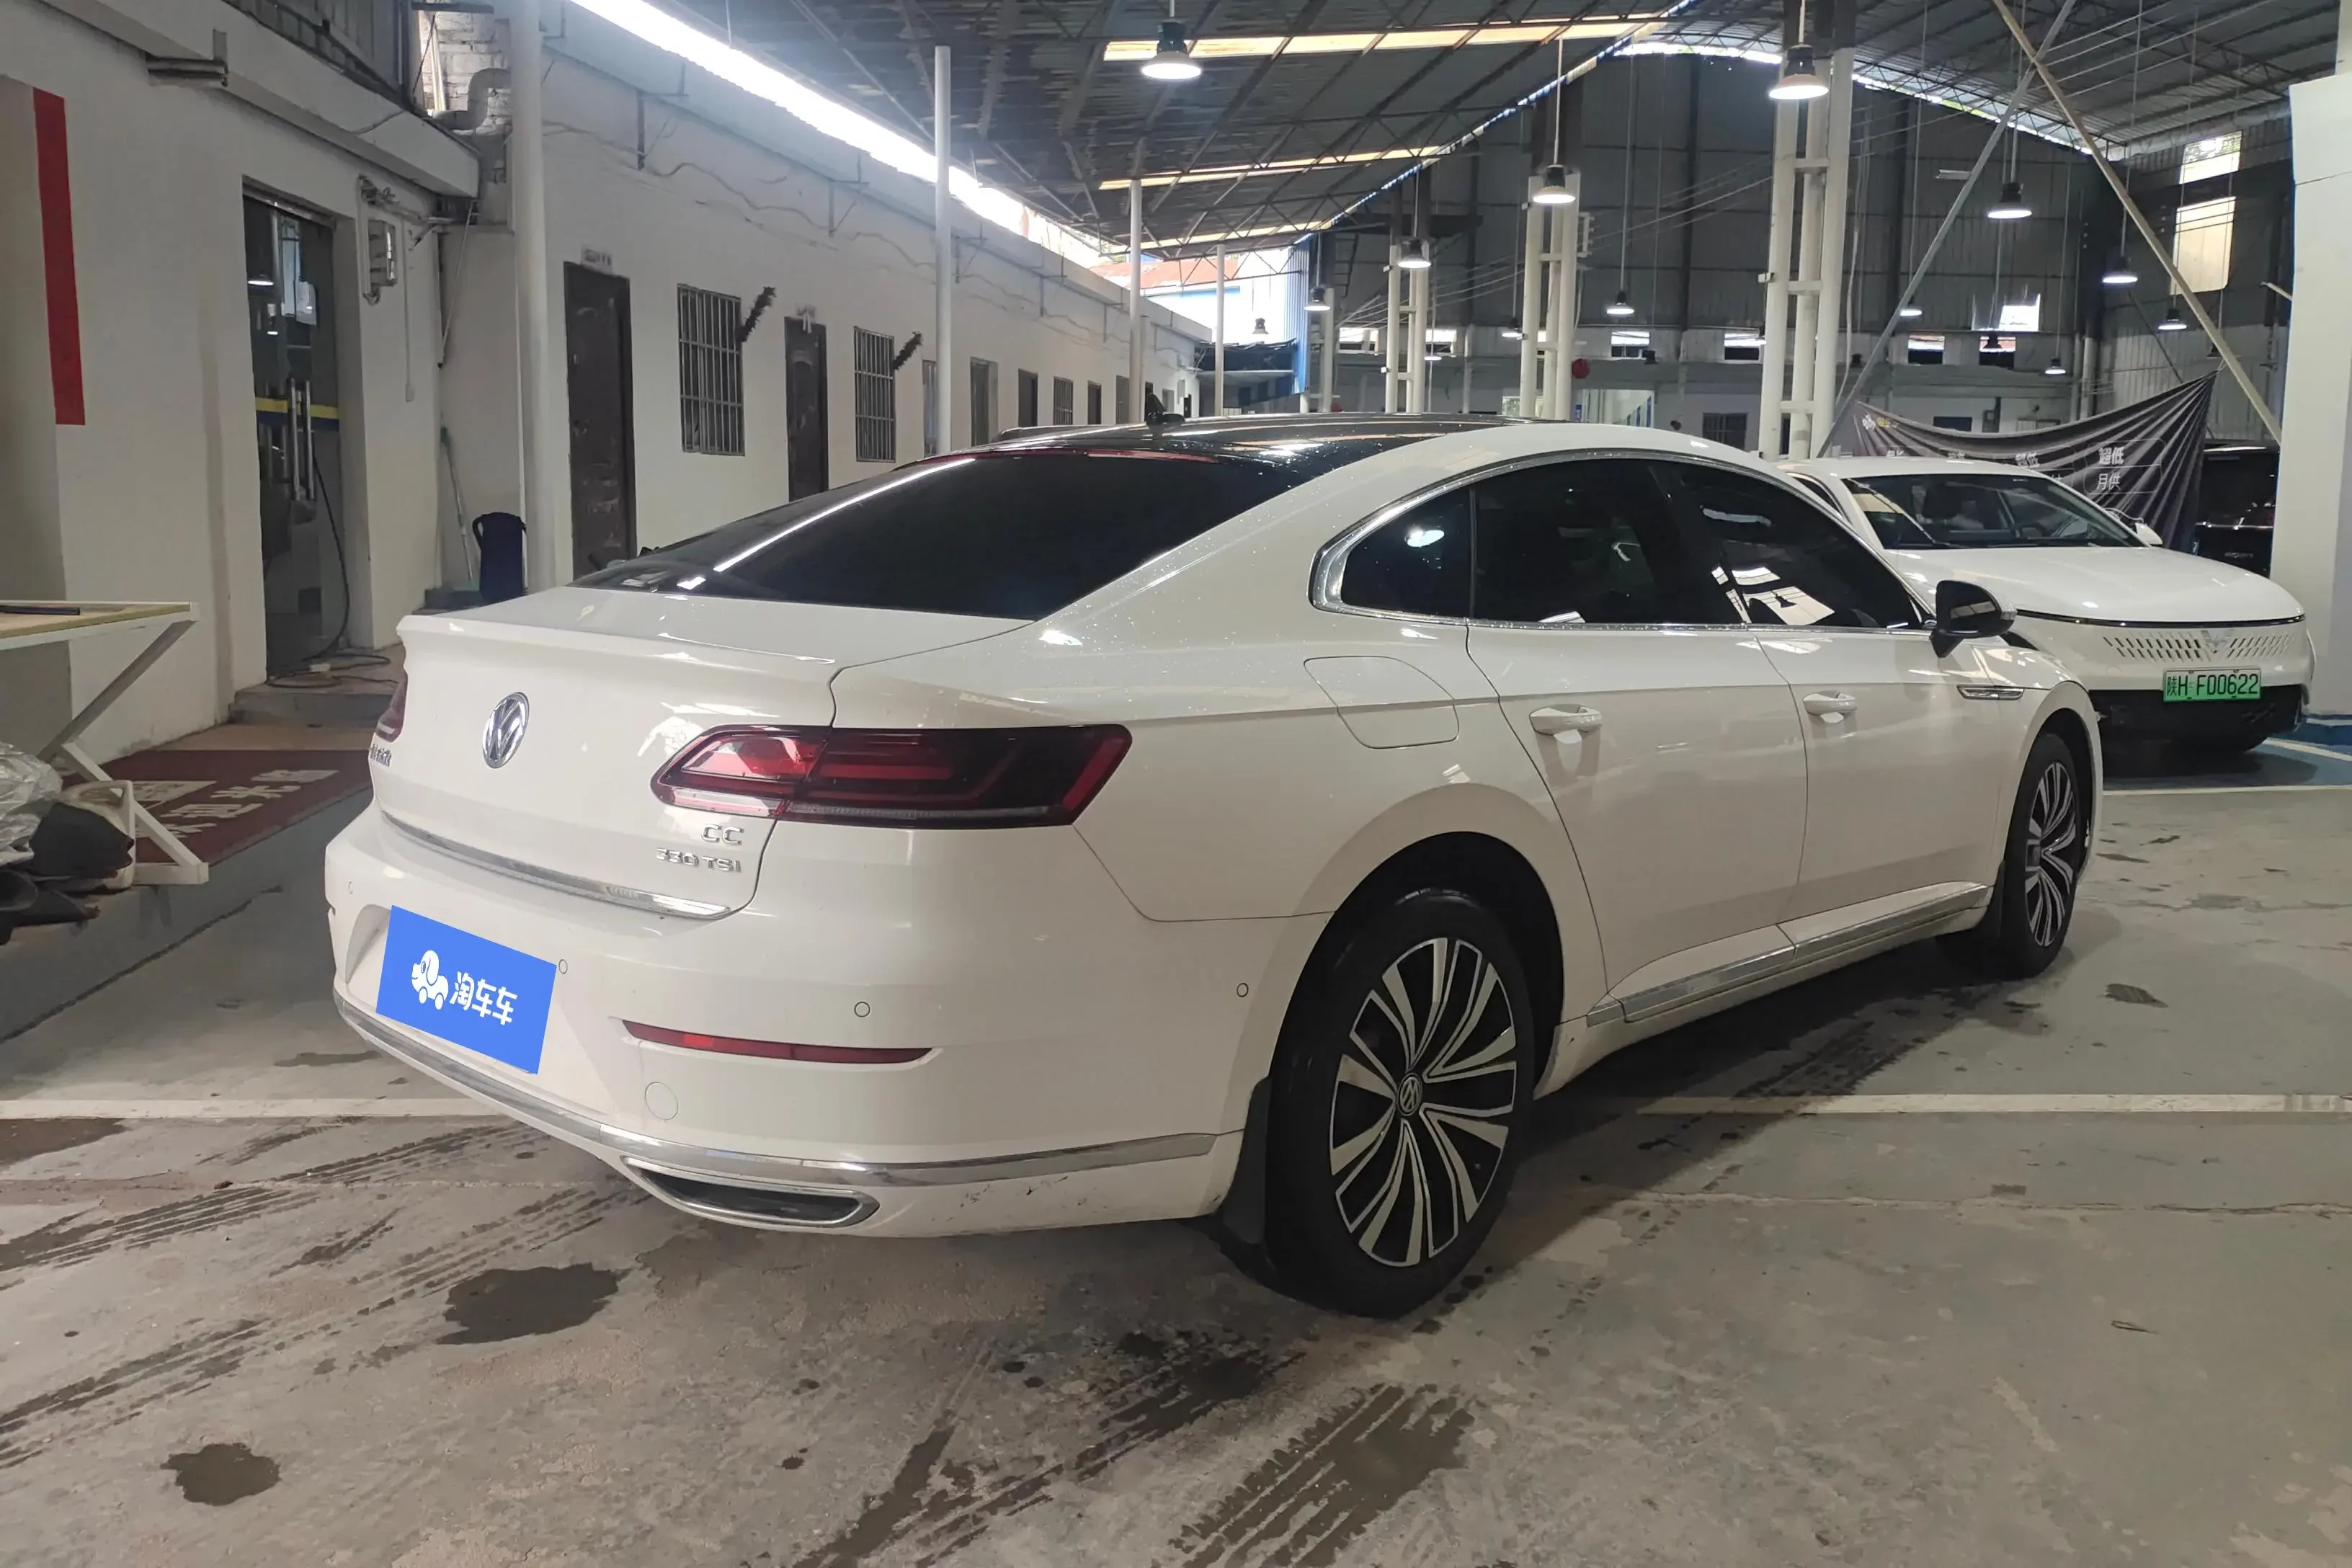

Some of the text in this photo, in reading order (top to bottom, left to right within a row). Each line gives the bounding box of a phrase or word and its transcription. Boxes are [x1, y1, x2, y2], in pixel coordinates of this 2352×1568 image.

[2098, 447, 2125, 465] 超低
[2096, 473, 2121, 491] 月供
[701, 824, 744, 845] CC
[702, 855, 741, 873] TSI
